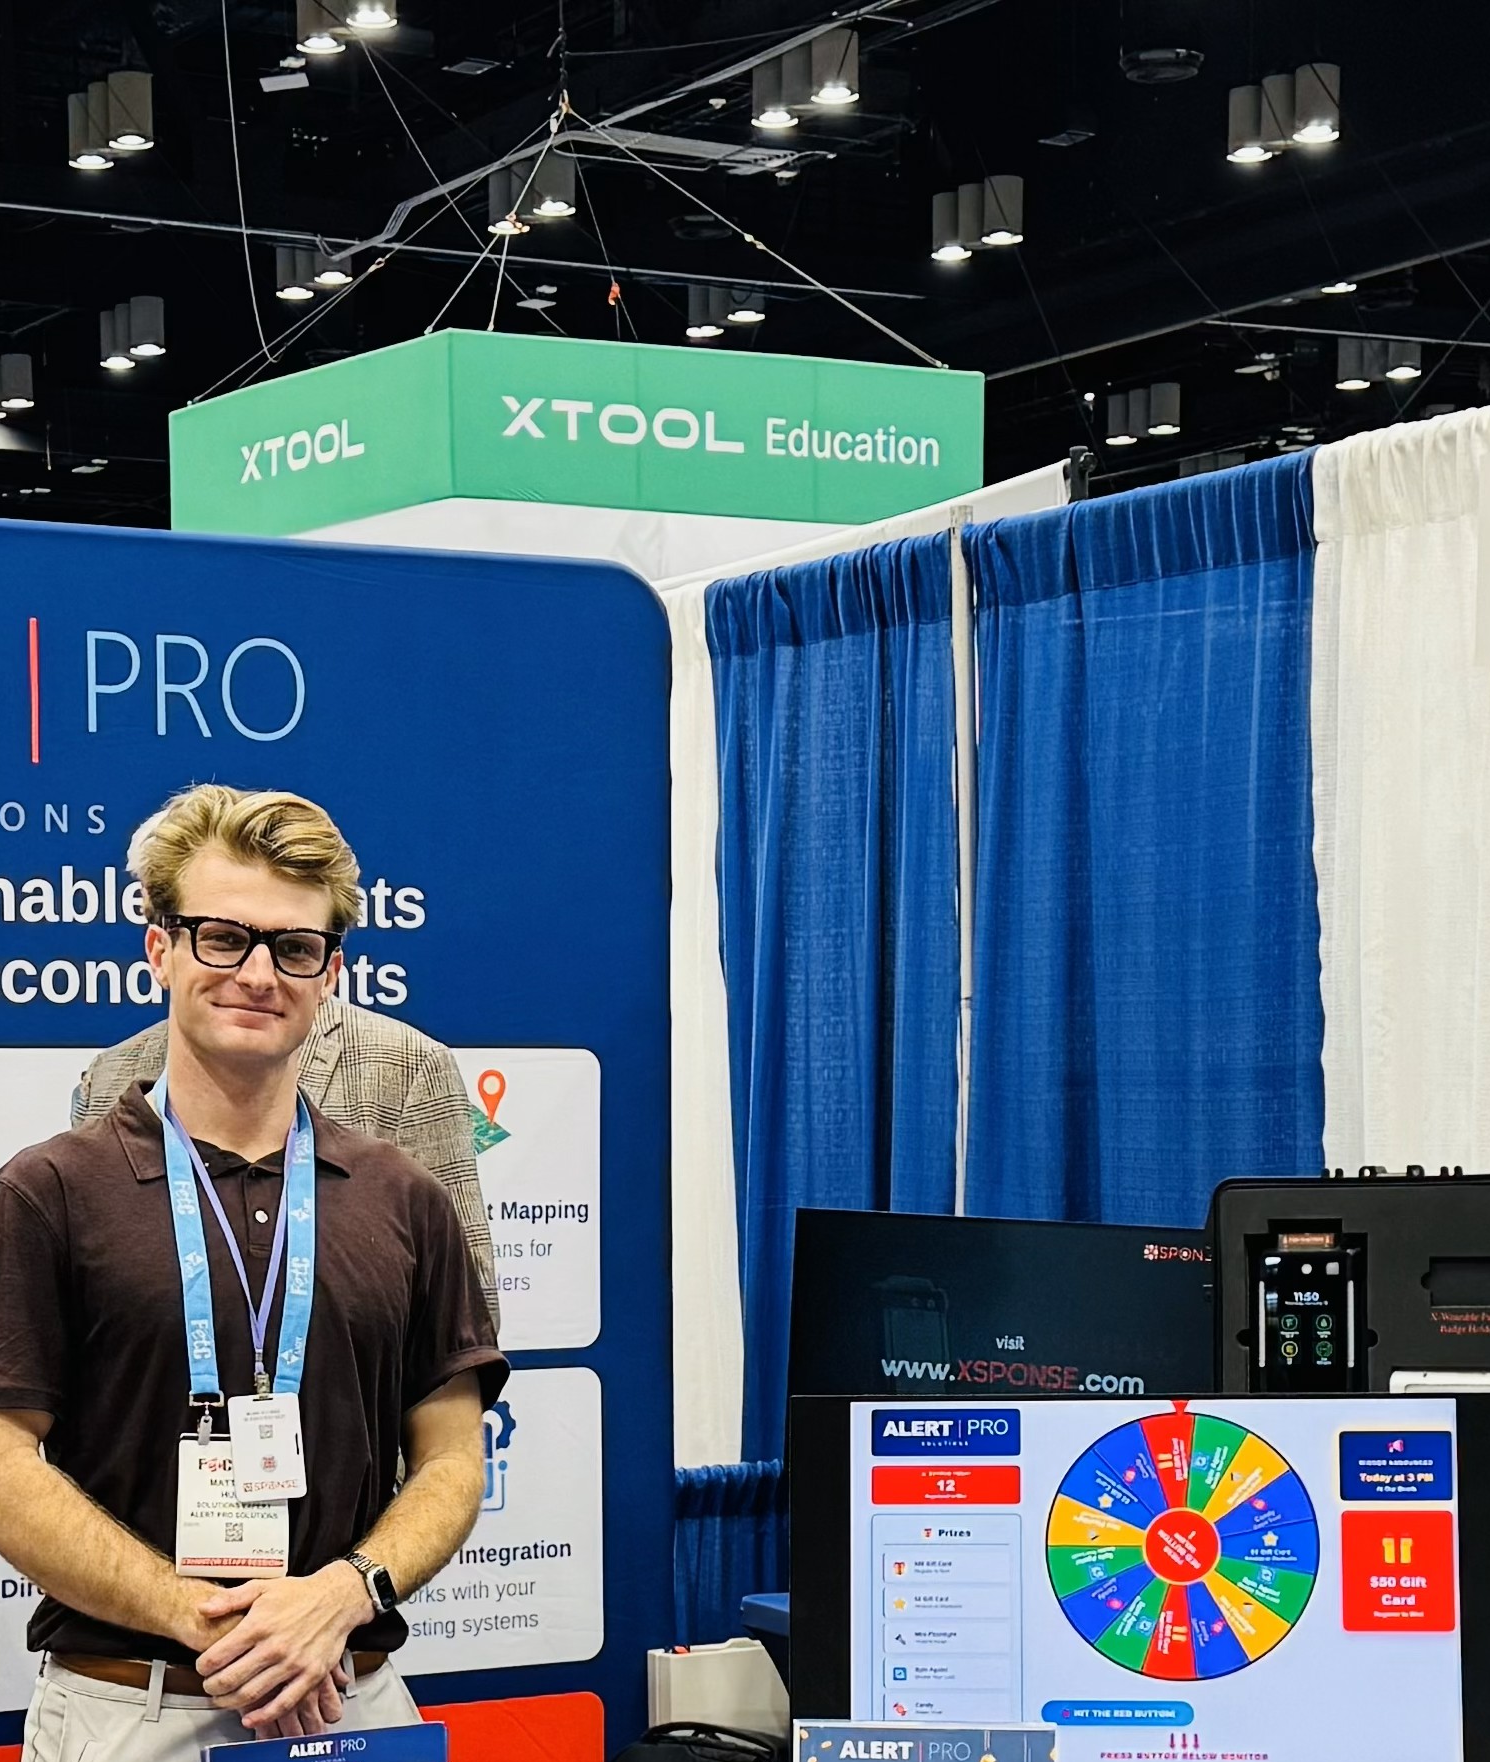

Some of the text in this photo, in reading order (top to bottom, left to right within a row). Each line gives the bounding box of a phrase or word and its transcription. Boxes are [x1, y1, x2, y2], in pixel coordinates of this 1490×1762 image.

[501, 395, 941, 468] XTOOL Education
[240, 418, 365, 485] XTOOL
[84, 628, 306, 742] PRO
[500, 1198, 590, 1224] Mapping
[529, 1239, 554, 1257] for
[995, 1335, 1025, 1351] visit
[882, 1359, 1145, 1395] www.XSPONSE.com
[882, 1419, 1009, 1437] ALERT PRO
[936, 1480, 956, 1492] 12
[1359, 1473, 1392, 1484] Today
[1394, 1474, 1405, 1482] at
[1407, 1473, 1415, 1482] 3
[459, 1540, 572, 1567] Integration
[451, 1579, 537, 1603] with your
[1370, 1576, 1428, 1588] $50 Gift
[1381, 1594, 1416, 1606] Card
[461, 1611, 539, 1635] systems
[1092, 1709, 1110, 1718] THE
[289, 1737, 367, 1758] ALERT PRO
[839, 1740, 972, 1762] ALERT PRO
